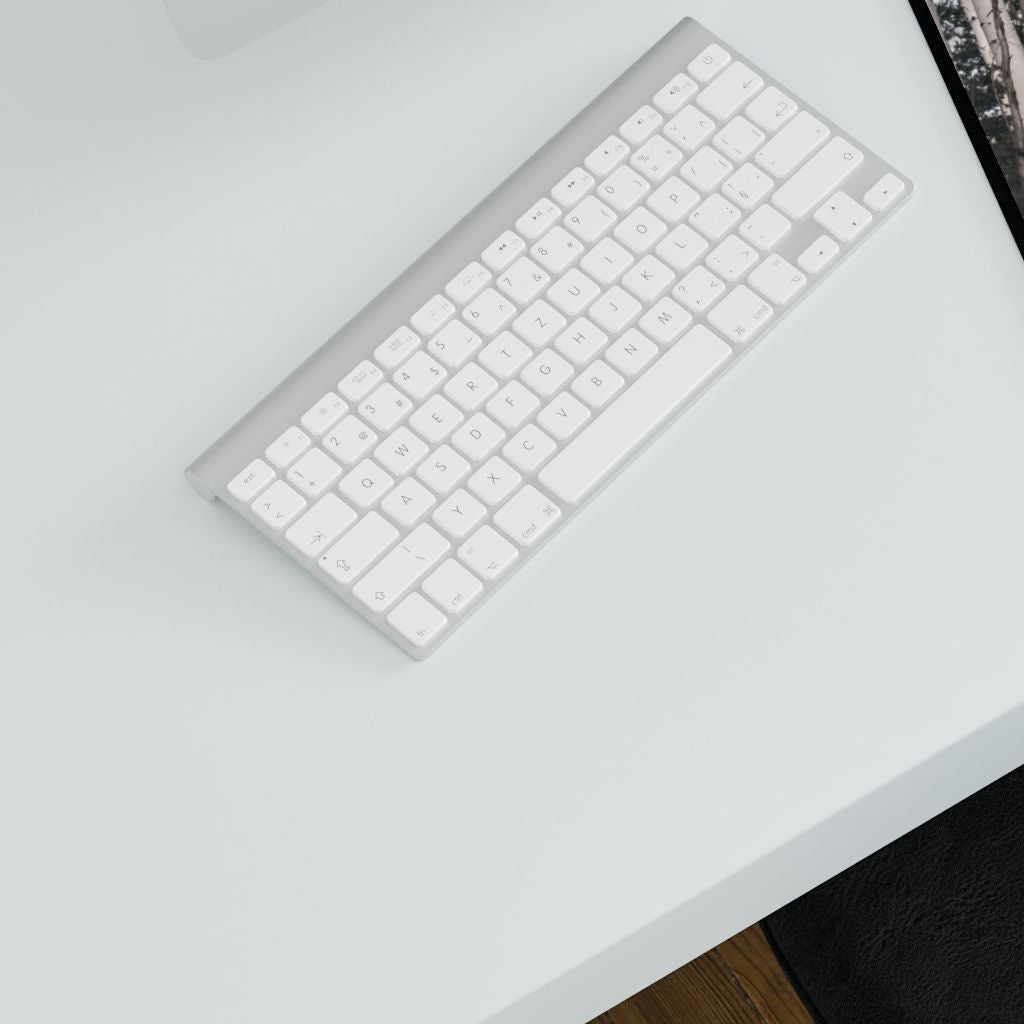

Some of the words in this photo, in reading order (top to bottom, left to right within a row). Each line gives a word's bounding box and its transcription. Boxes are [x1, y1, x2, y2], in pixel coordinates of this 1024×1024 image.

[293, 470, 305, 479] 1
[329, 436, 342, 447] 2
[365, 404, 376, 415] 3
[401, 371, 412, 381] 4
[434, 340, 446, 351] 5
[470, 309, 480, 319] 6
[502, 277, 513, 288] 7
[537, 247, 548, 256] 8
[570, 216, 581, 225] 9
[604, 184, 615, 195] 0
[360, 477, 375, 489] Q
[393, 443, 410, 457] W
[431, 412, 444, 424] E
[465, 380, 479, 392] R
[499, 348, 512, 359] T
[534, 316, 548, 329] Z
[567, 284, 581, 297] U
[636, 224, 648, 235] O
[668, 193, 679, 204] P
[400, 495, 414, 507] A
[434, 461, 448, 472] S
[468, 429, 482, 441] D
[504, 396, 515, 408] F
[539, 364, 552, 375] G
[571, 331, 587, 345] H
[608, 301, 619, 312] J
[639, 269, 654, 281] K
[673, 241, 687, 250] L
[450, 504, 464, 516] Y
[486, 472, 501, 486] X
[522, 440, 535, 451] C
[555, 407, 568, 418] V
[590, 376, 603, 388] B
[623, 343, 639, 356] N
[657, 311, 673, 326] M
